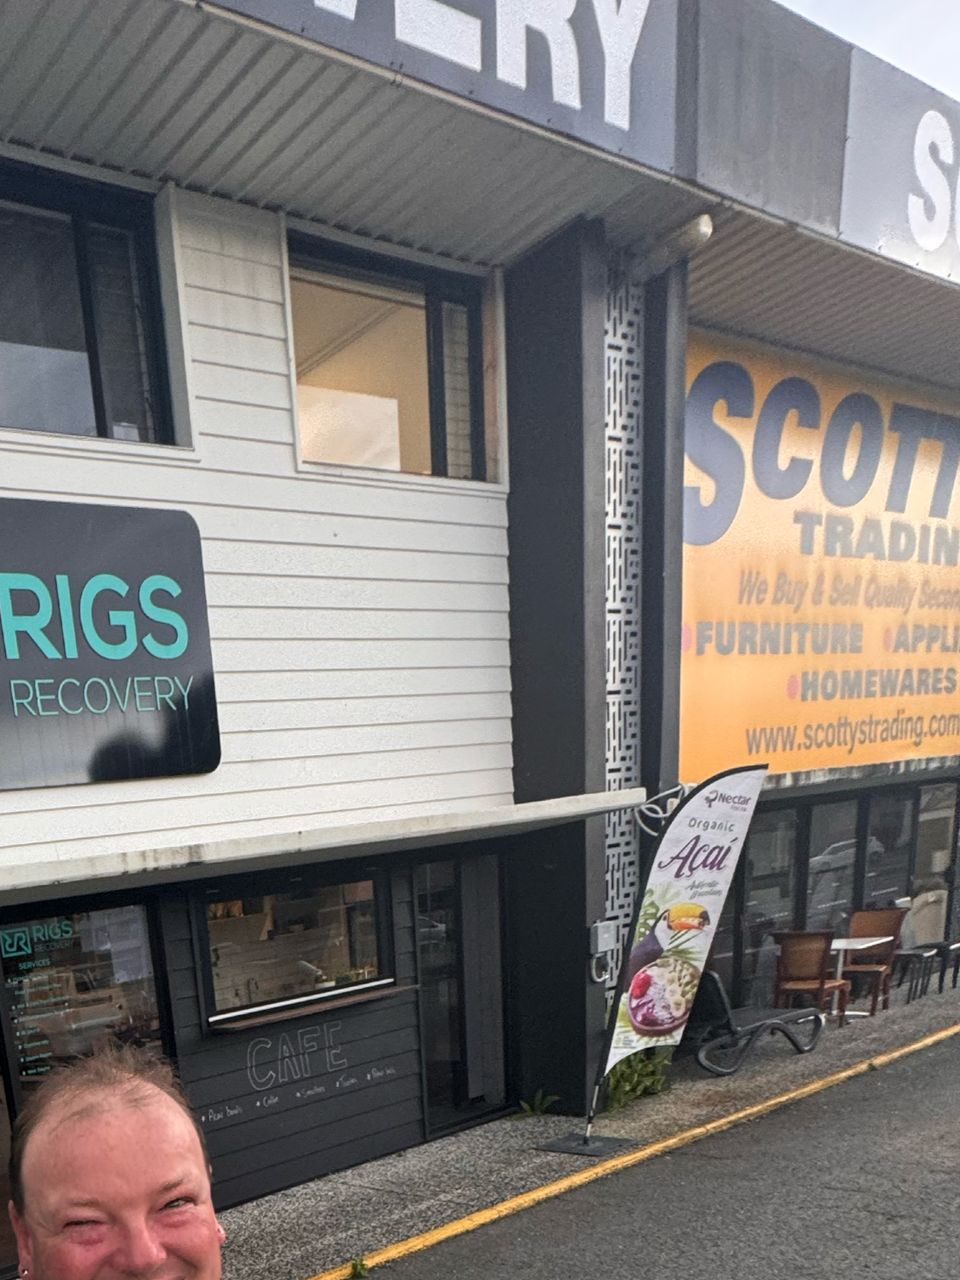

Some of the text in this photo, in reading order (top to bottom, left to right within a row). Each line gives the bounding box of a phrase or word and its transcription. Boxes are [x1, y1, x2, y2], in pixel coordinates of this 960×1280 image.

[908, 110, 960, 252] S
[794, 509, 960, 567] TRADIN
[739, 570, 769, 605] We
[771, 570, 809, 613] Buy
[828, 574, 863, 607] Sell
[864, 576, 917, 615] Quality
[695, 620, 864, 656] FURNITURE
[9, 676, 194, 718] RECOVERY
[800, 667, 957, 701] HOMEWARES
[745, 709, 960, 756] www.scottystrading.com
[719, 793, 751, 806] Nectar
[688, 817, 735, 832] Organic
[32, 920, 73, 942] RIGS
[248, 1021, 347, 1090] CAFE
